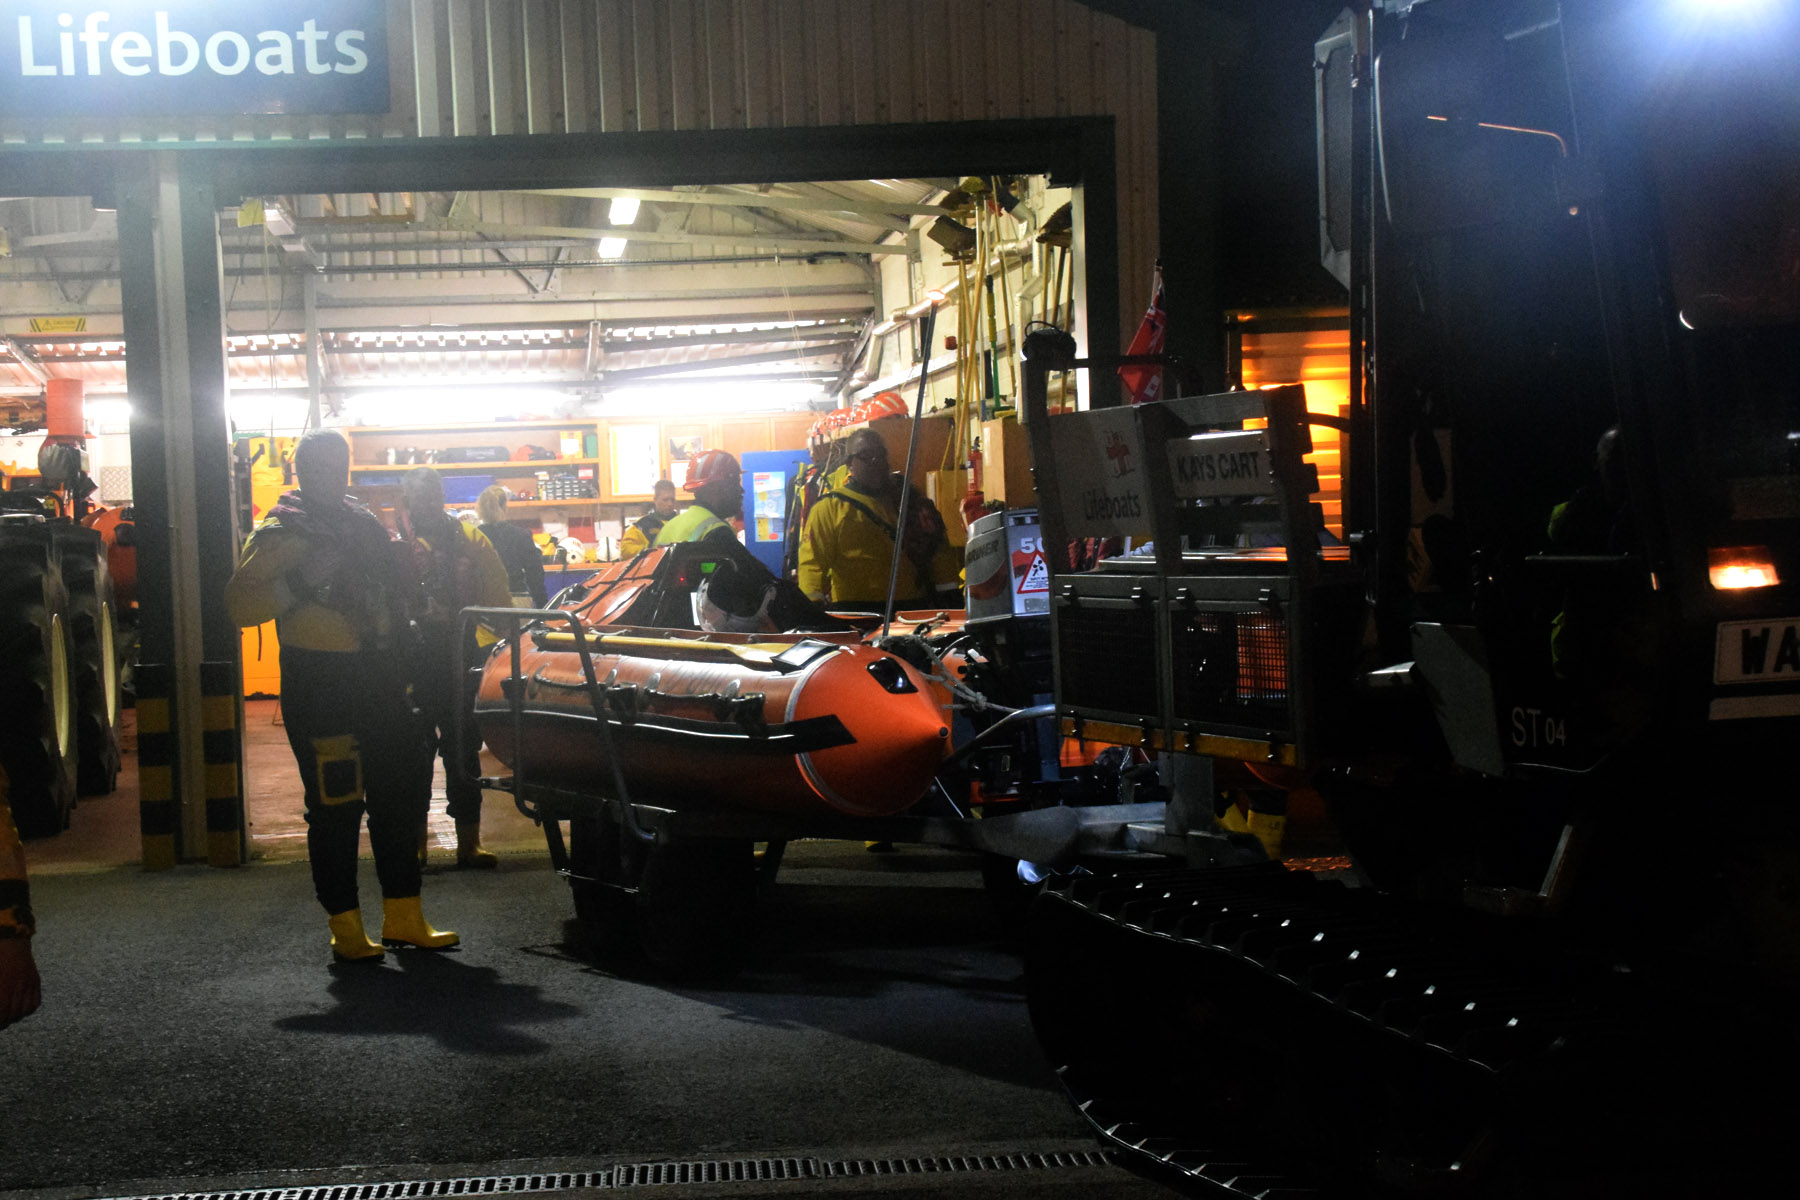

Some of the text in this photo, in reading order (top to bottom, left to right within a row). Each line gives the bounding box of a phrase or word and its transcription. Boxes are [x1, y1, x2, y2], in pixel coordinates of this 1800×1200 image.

[17, 11, 369, 77] Lifeboats
[1177, 450, 1260, 483] KAYS CART
[1083, 488, 1141, 520] Lifeboats
[1511, 706, 1568, 749] ST 04
